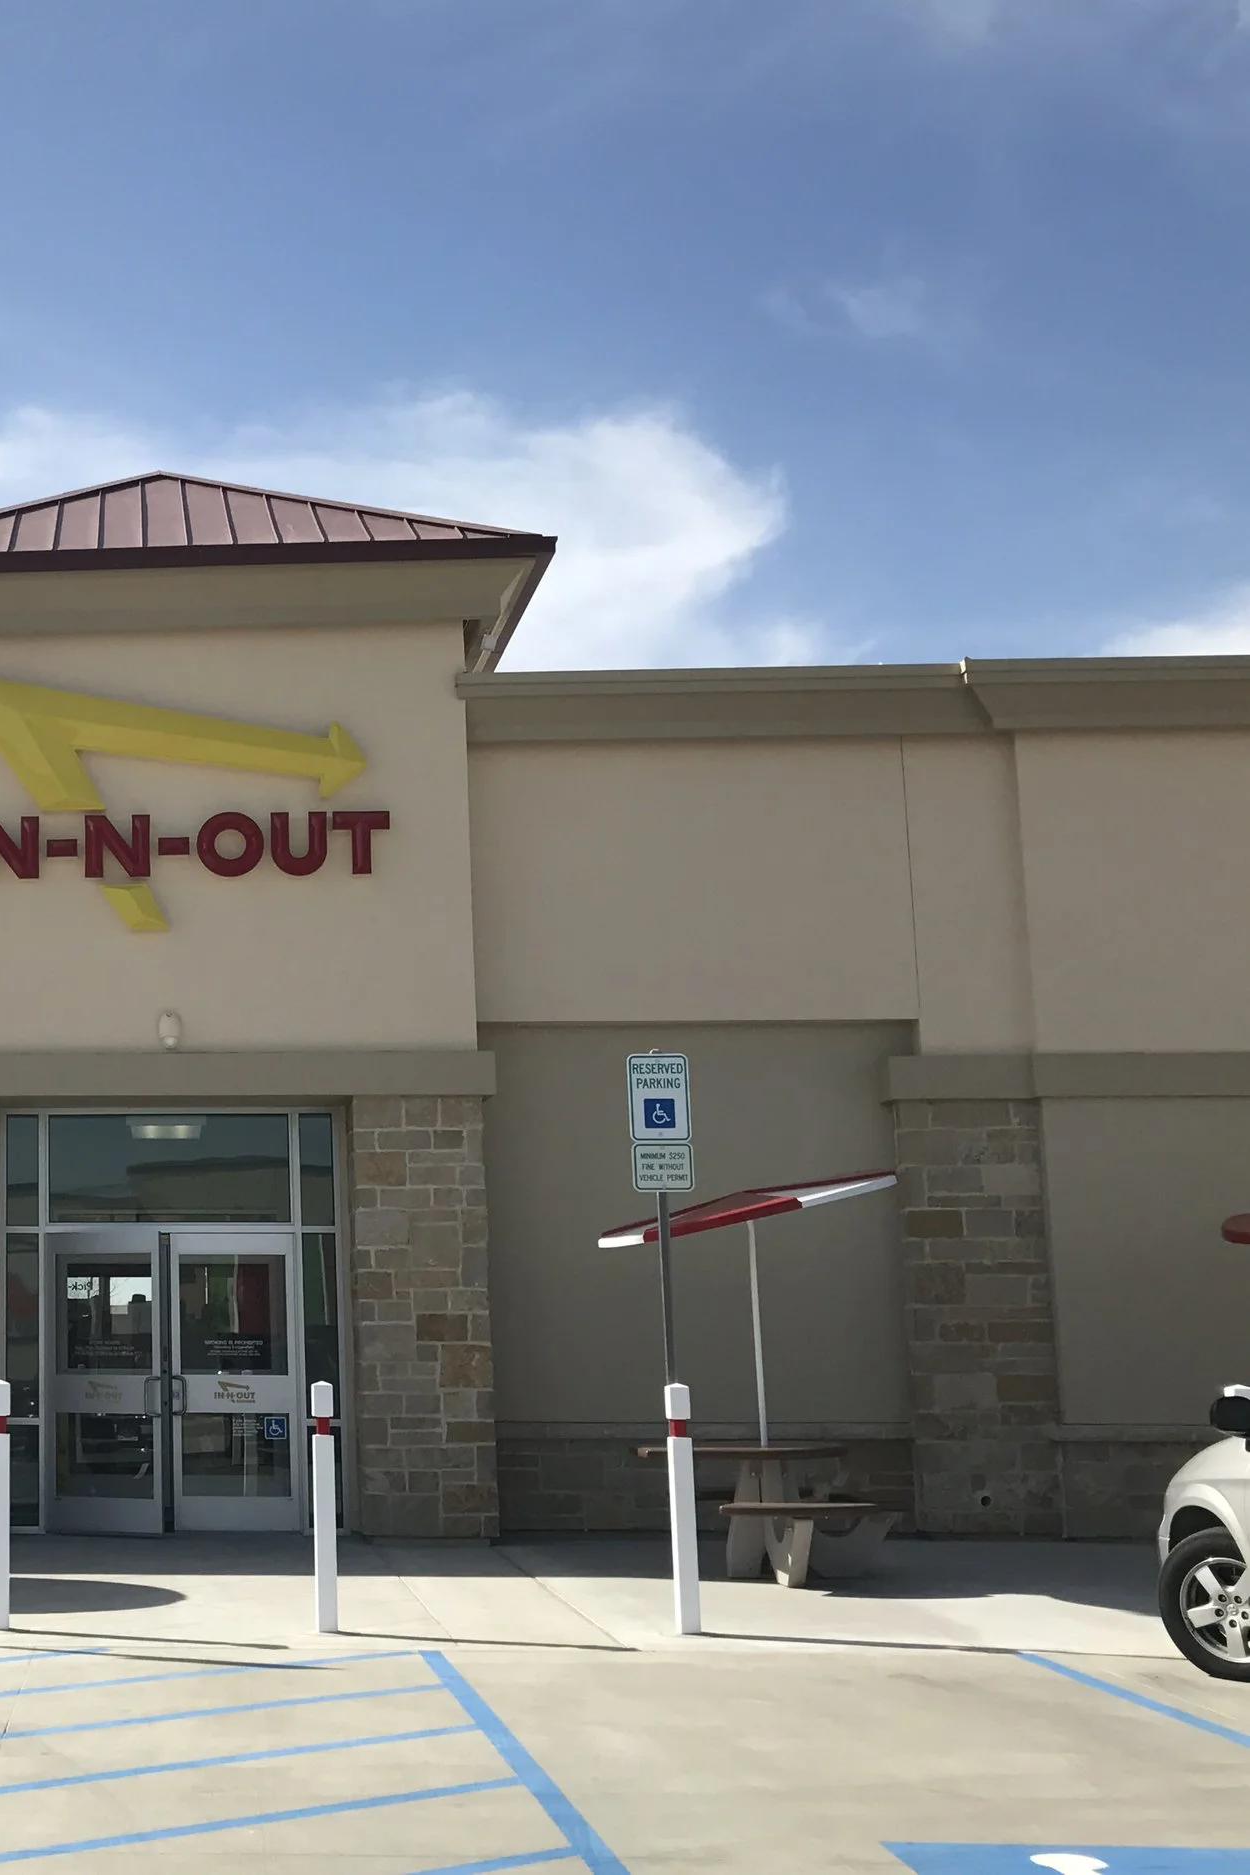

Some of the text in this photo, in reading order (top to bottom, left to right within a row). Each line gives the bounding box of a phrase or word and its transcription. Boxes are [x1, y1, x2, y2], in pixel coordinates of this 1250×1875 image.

[632, 1063, 684, 1075] RESERVED
[636, 1077, 681, 1089] PARKING
[640, 1152, 685, 1160] MINIMUM $250
[641, 1163, 684, 1171] FINE WITHOUT
[638, 1174, 688, 1182] VEHICLE PERMIT
